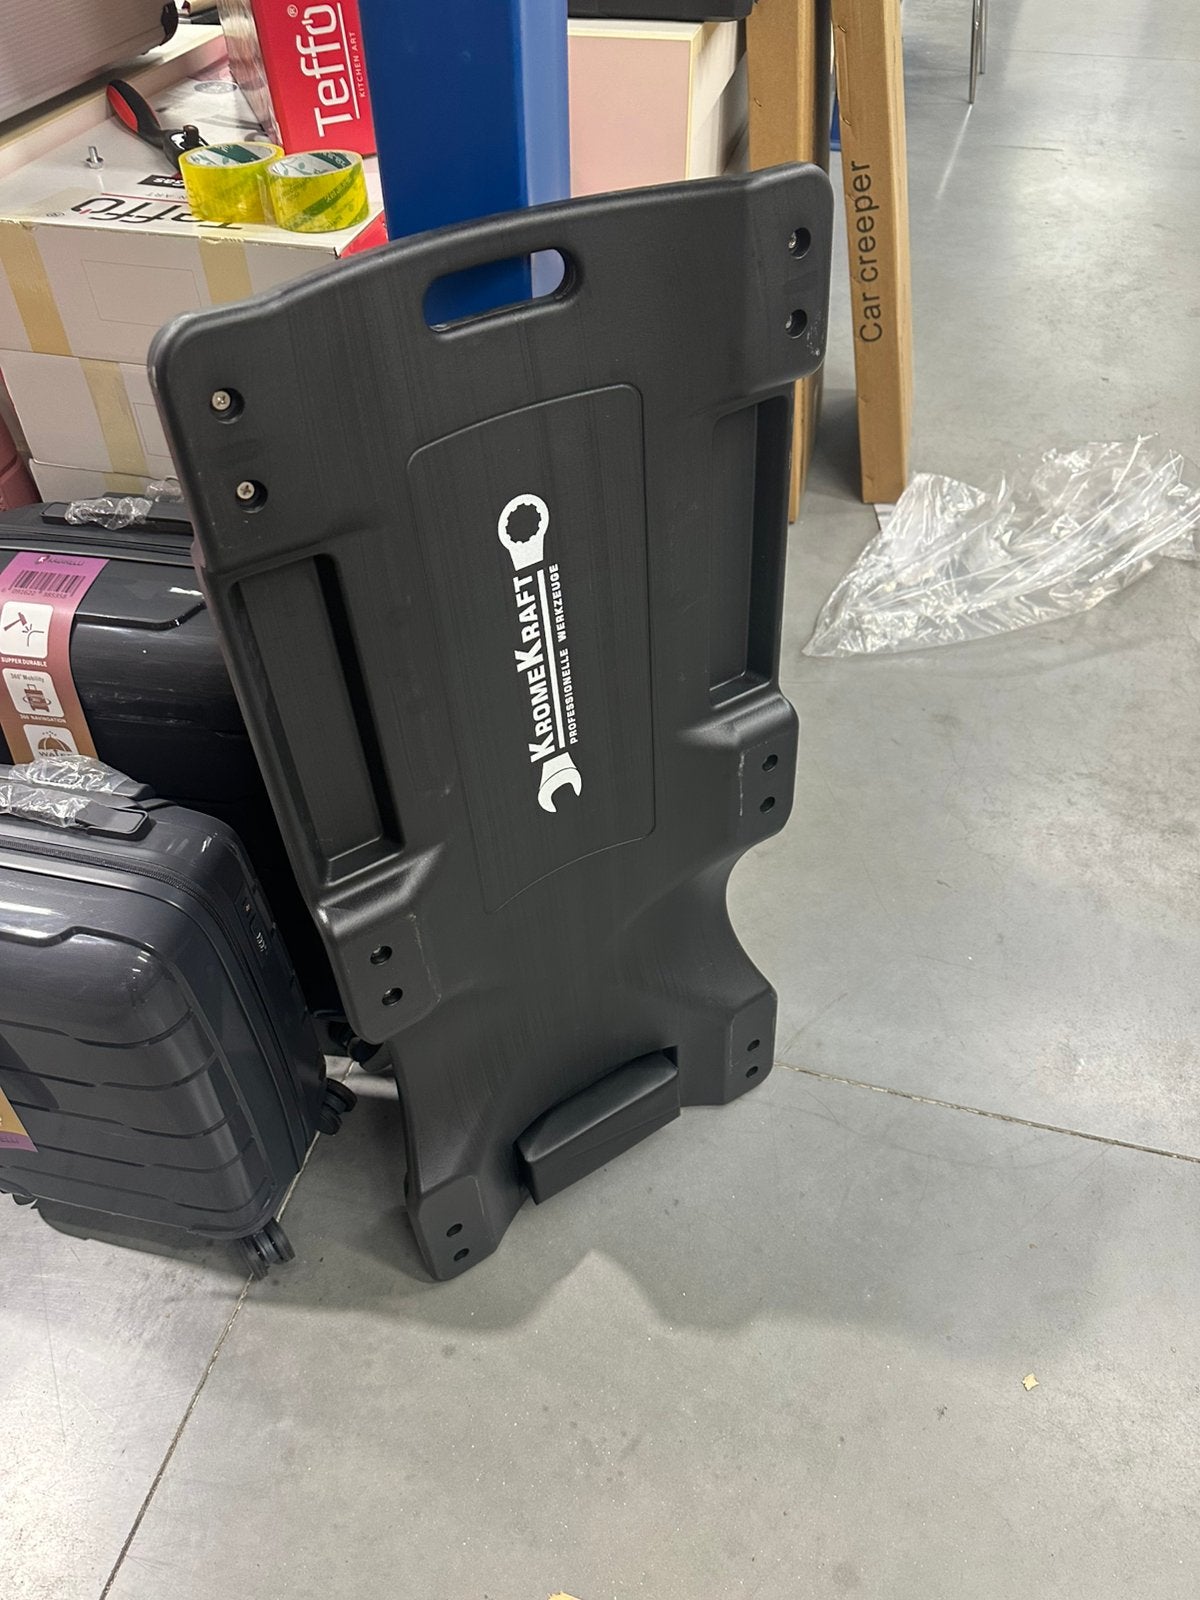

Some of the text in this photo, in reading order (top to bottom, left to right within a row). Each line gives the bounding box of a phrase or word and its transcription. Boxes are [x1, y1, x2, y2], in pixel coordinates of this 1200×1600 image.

[296, 4, 353, 138] Teffo
[348, 31, 366, 98] KITCHEN ART
[851, 160, 882, 343] Car creeper
[1, 656, 48, 668] SUPPER DURABLE
[549, 563, 578, 745] PROFESSIONELLE WERKZEUGE
